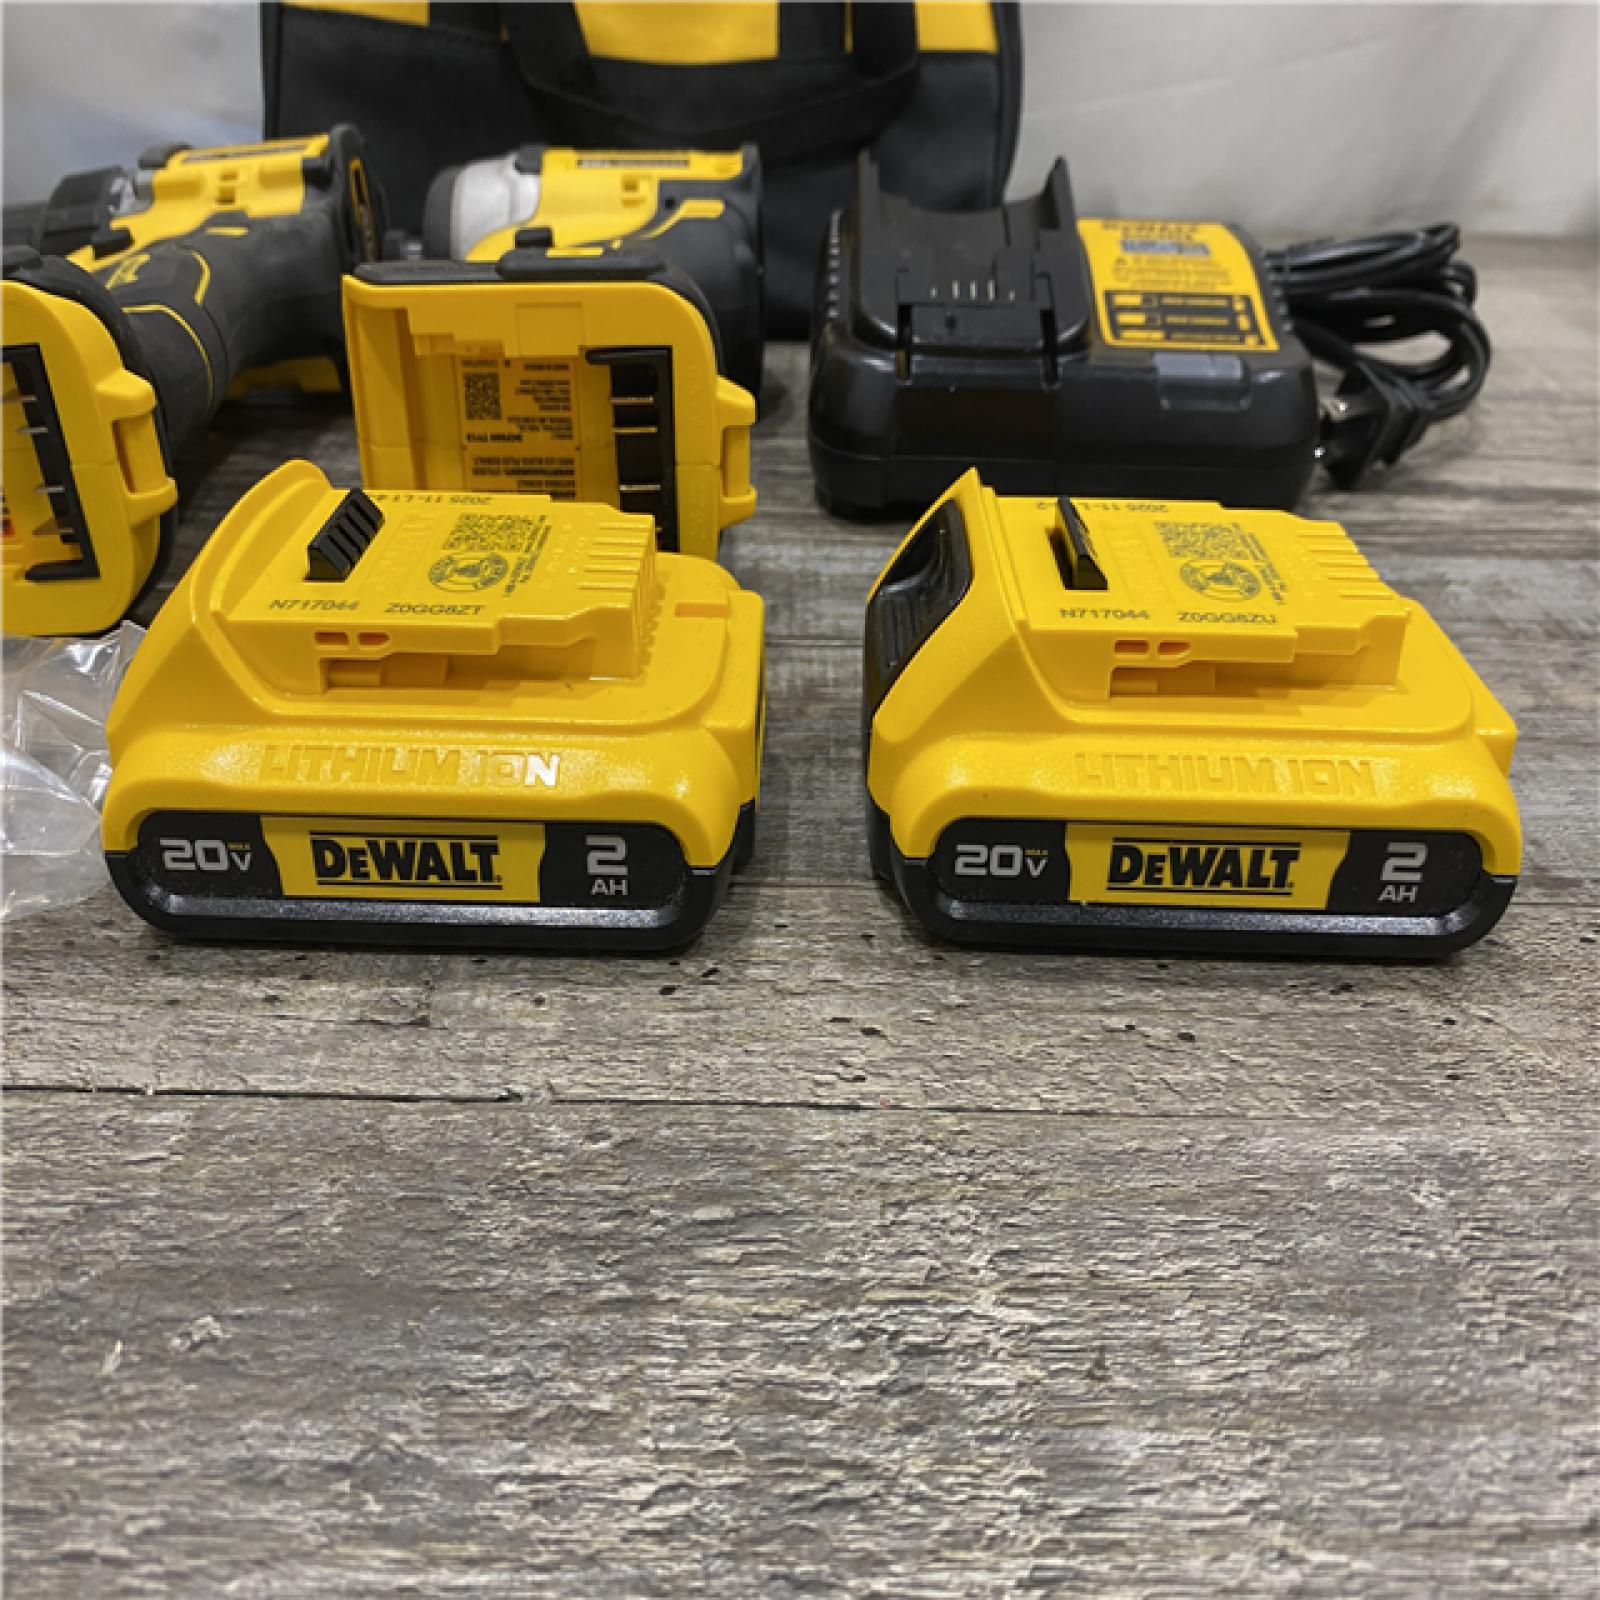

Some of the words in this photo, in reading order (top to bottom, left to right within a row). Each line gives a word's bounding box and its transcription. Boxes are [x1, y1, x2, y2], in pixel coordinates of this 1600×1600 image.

[269, 599, 360, 611] N717044
[1059, 607, 1150, 620] N717044
[259, 744, 463, 786] LITHIUM
[472, 750, 561, 787] ION
[1073, 752, 1277, 792] LITHIUM
[1284, 759, 1378, 797] ION
[311, 839, 499, 882] DEWALT
[585, 835, 628, 876] 2
[1107, 844, 1300, 888] DEWALT
[1379, 841, 1429, 882] 2
[591, 878, 629, 896] AH
[1378, 884, 1419, 903] AH
